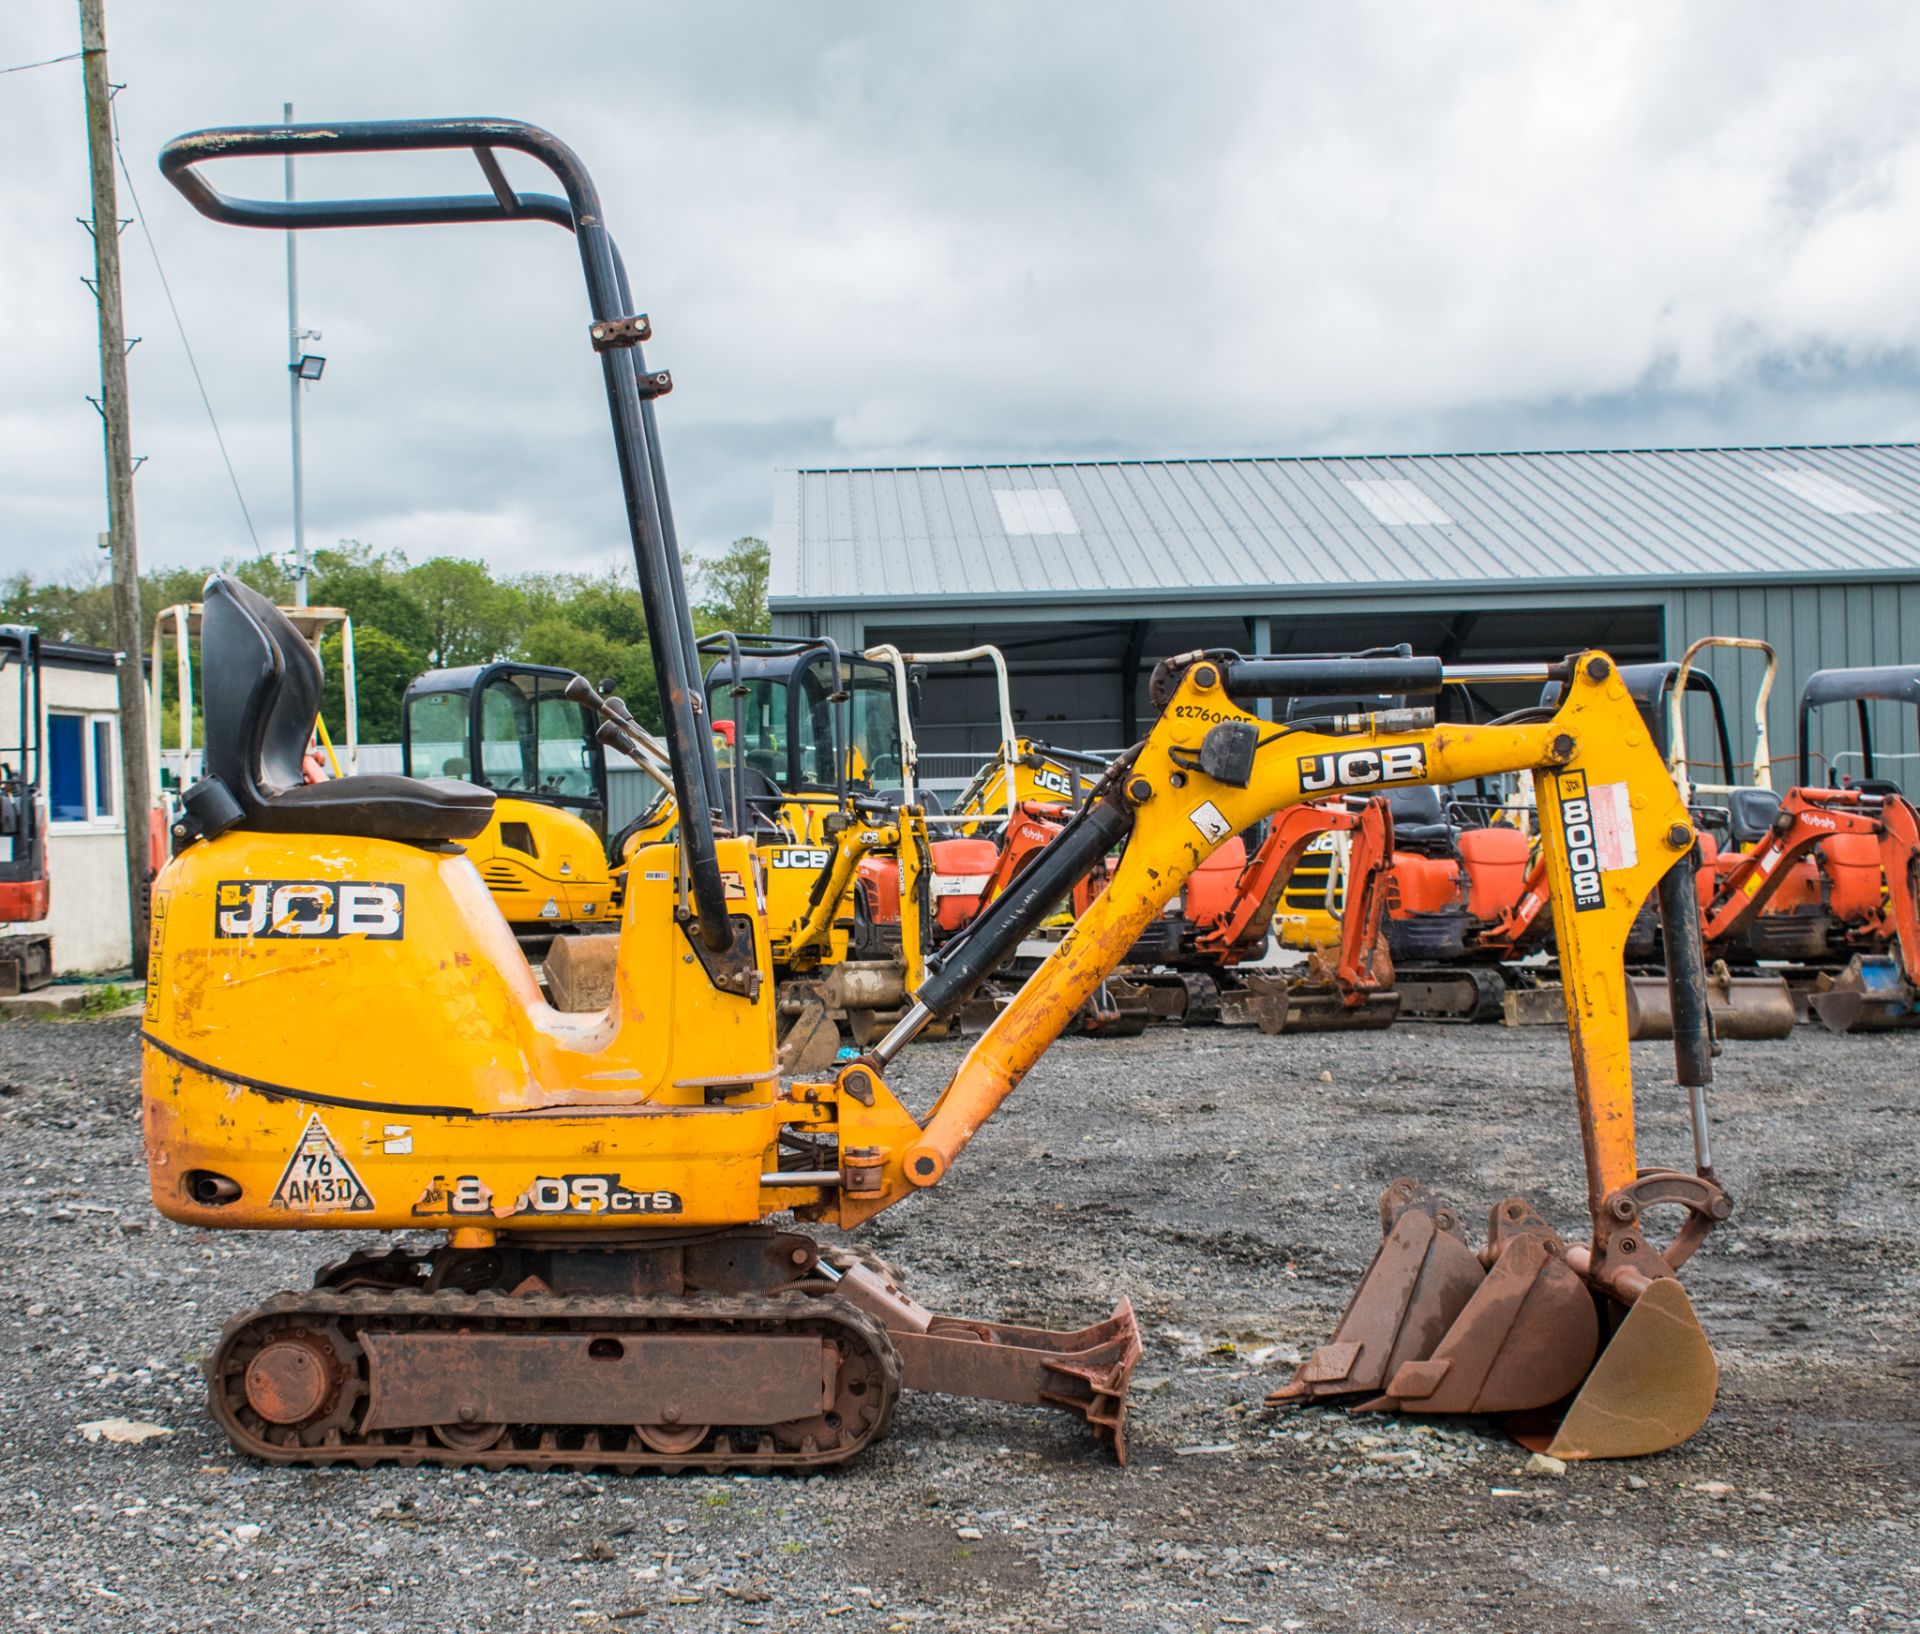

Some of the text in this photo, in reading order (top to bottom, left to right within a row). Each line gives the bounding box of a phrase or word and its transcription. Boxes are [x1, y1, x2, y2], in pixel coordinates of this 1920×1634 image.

[1175, 706, 1252, 724] 22760
[1303, 747, 1424, 790] JCB
[1801, 812, 1837, 830] Kubota
[861, 831, 879, 844] JCB
[1563, 800, 1600, 896] 8008
[773, 850, 829, 868] JCB
[220, 884, 400, 935] JCB
[1577, 895, 1601, 906] CTS
[303, 1154, 332, 1177] 76
[452, 1178, 674, 1213] 808 CTS
